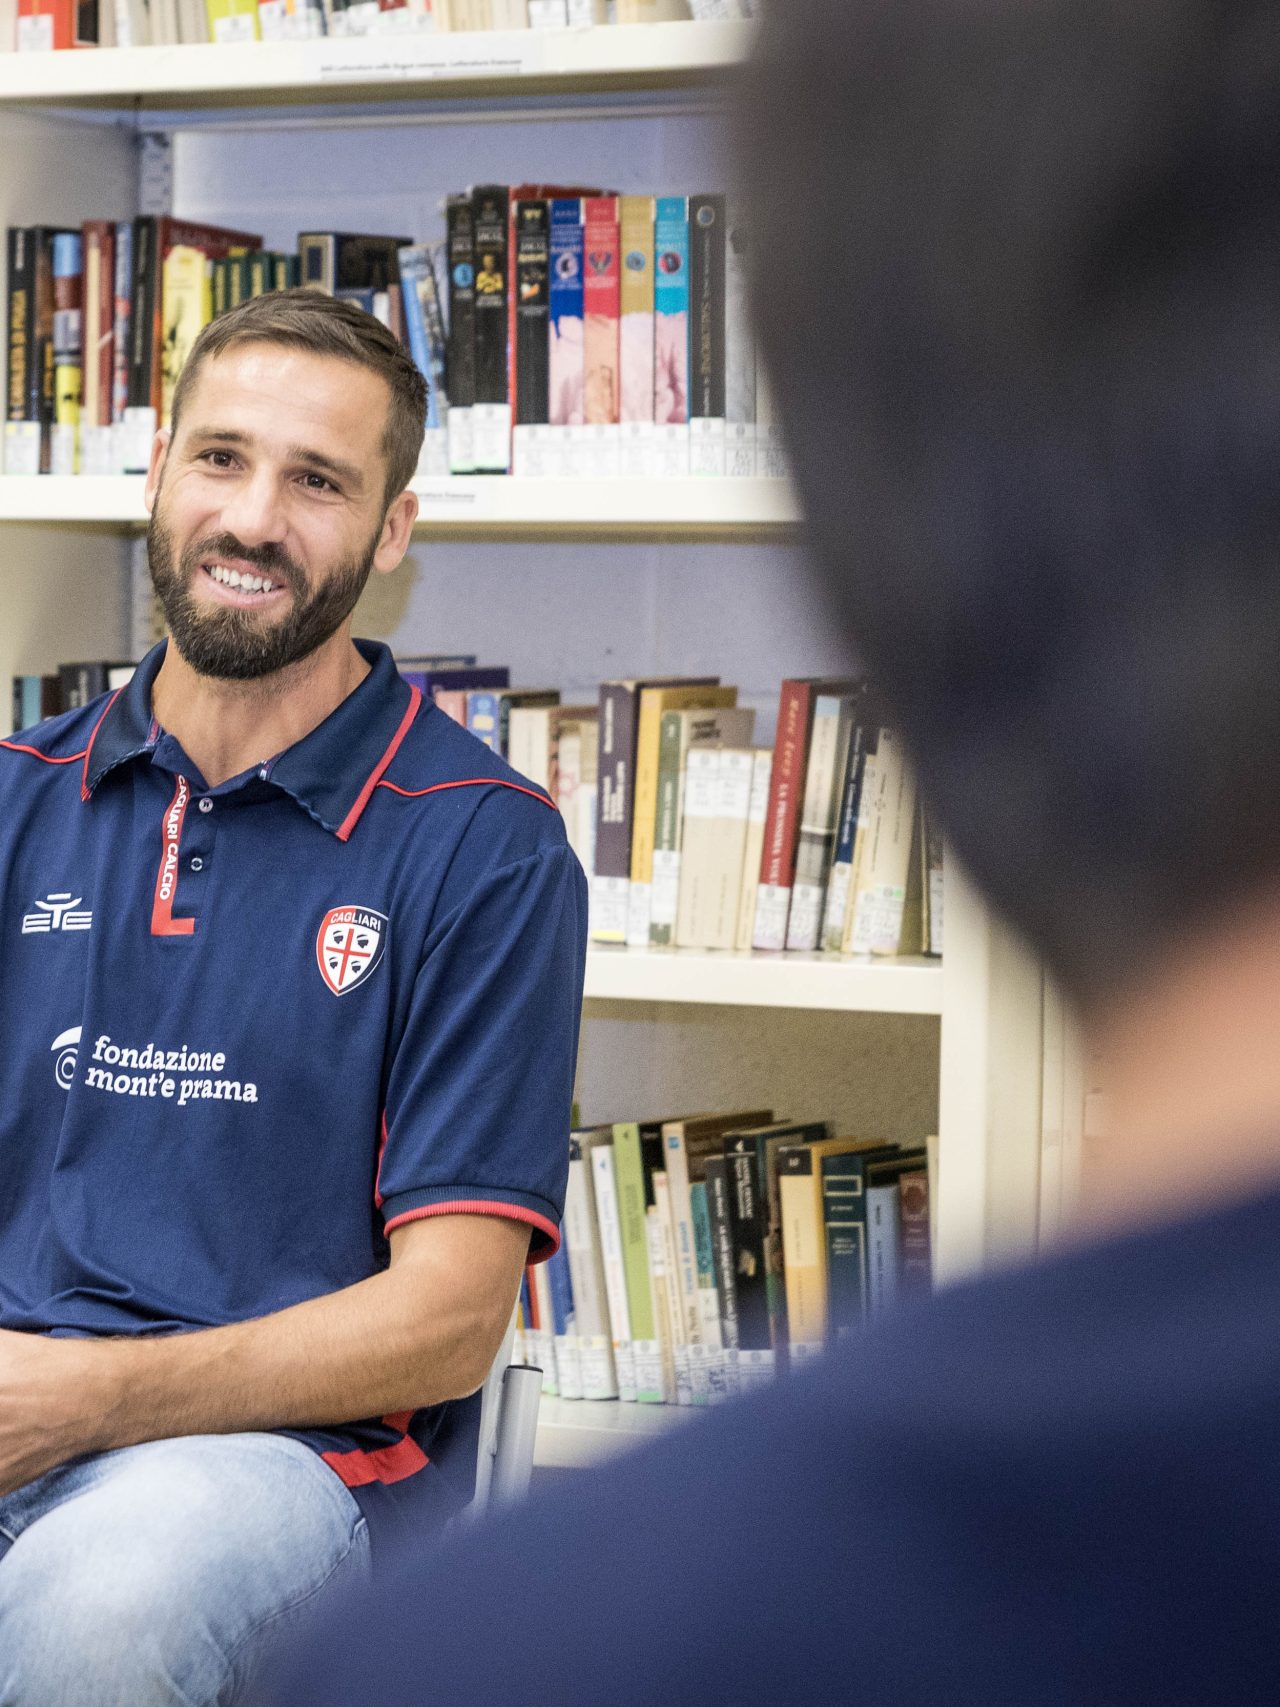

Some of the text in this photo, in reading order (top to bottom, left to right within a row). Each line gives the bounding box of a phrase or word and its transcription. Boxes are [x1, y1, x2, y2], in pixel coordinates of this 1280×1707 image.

[159, 774, 187, 900] CAGLIARI CALCIO
[330, 911, 381, 932] CAGLIARI
[91, 1034, 226, 1072] fondazione
[84, 1066, 259, 1106] mont'e prama
